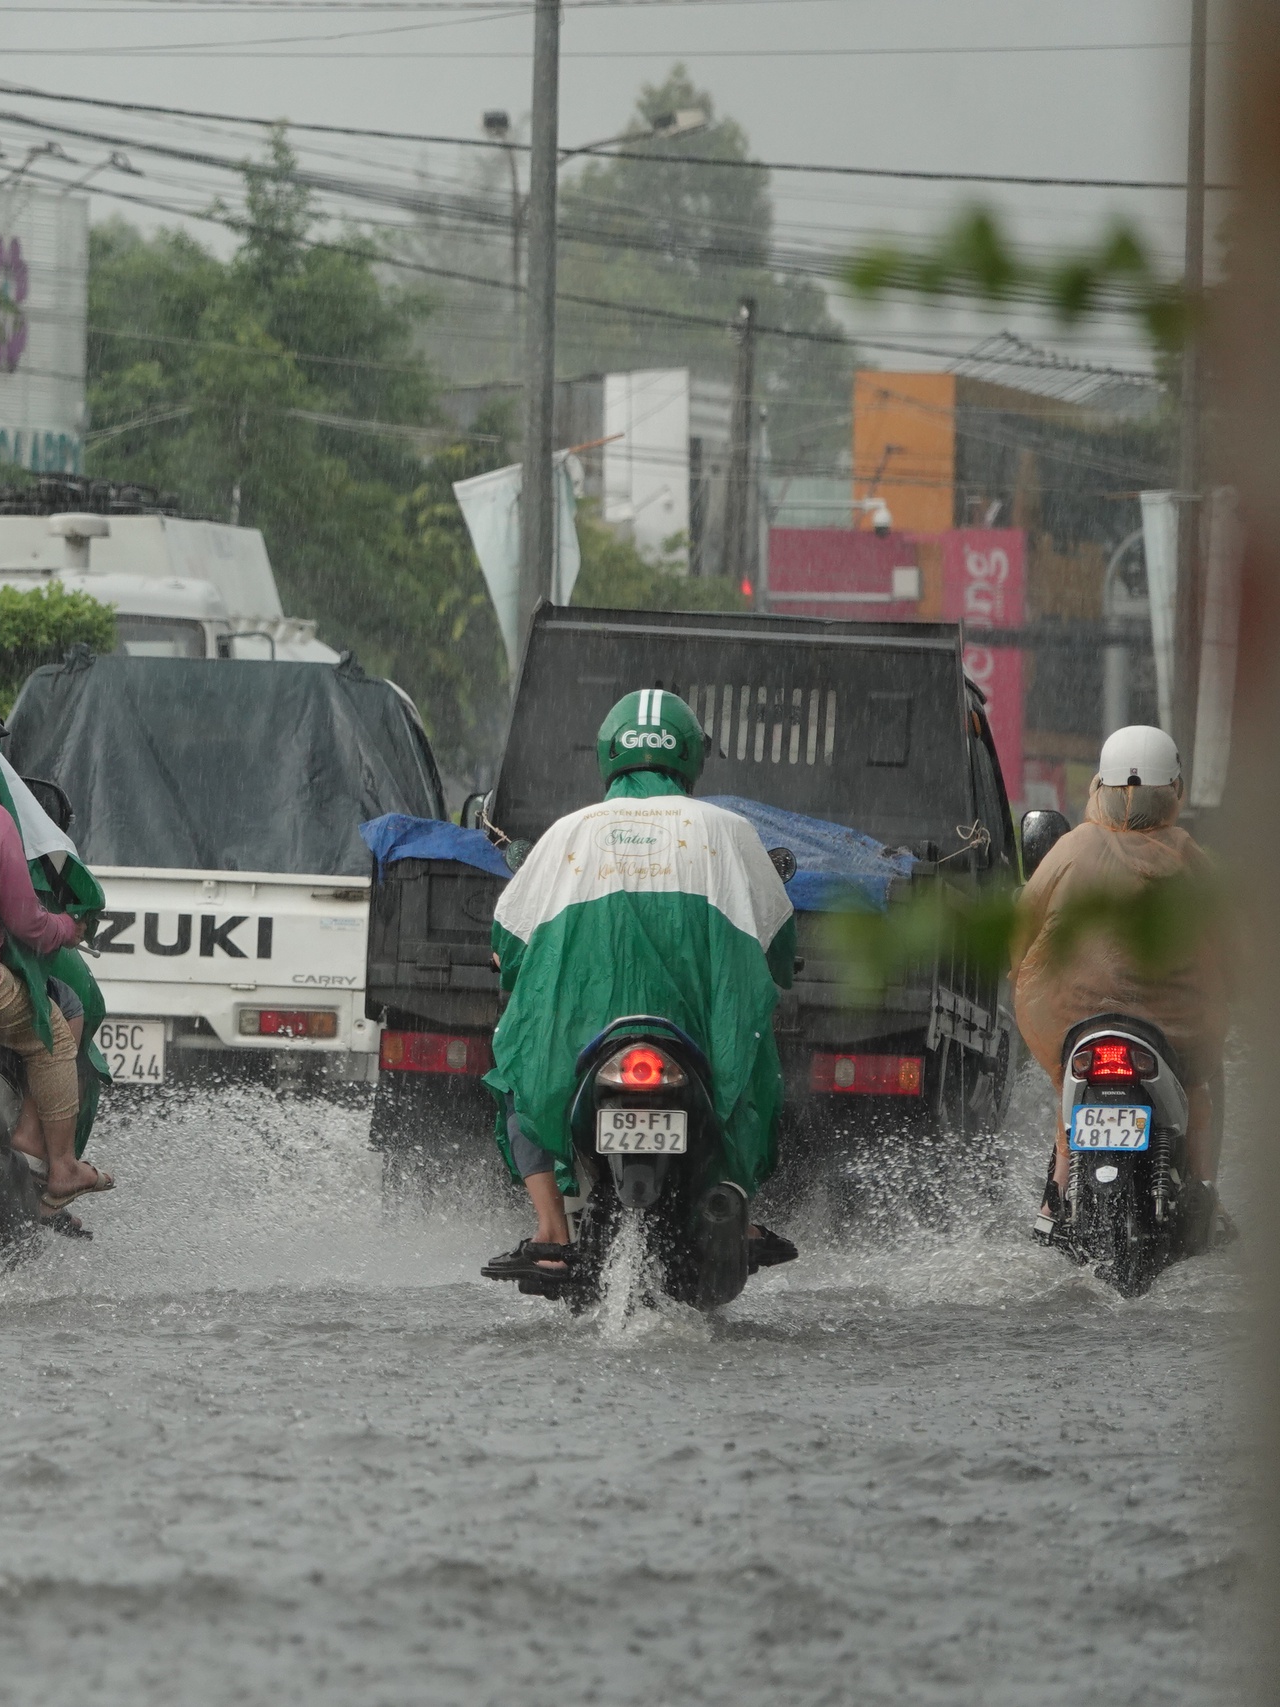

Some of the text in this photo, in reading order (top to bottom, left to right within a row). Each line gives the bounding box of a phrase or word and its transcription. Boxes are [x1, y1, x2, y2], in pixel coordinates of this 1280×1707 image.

[621, 729, 677, 750] Grab
[605, 828, 658, 847] Nature
[292, 974, 358, 986] CARRY
[100, 1024, 144, 1051] 65C
[612, 1112, 672, 1130] 69-F1
[602, 1132, 681, 1151] 242.92
[1075, 1128, 1144, 1147] 481.27
